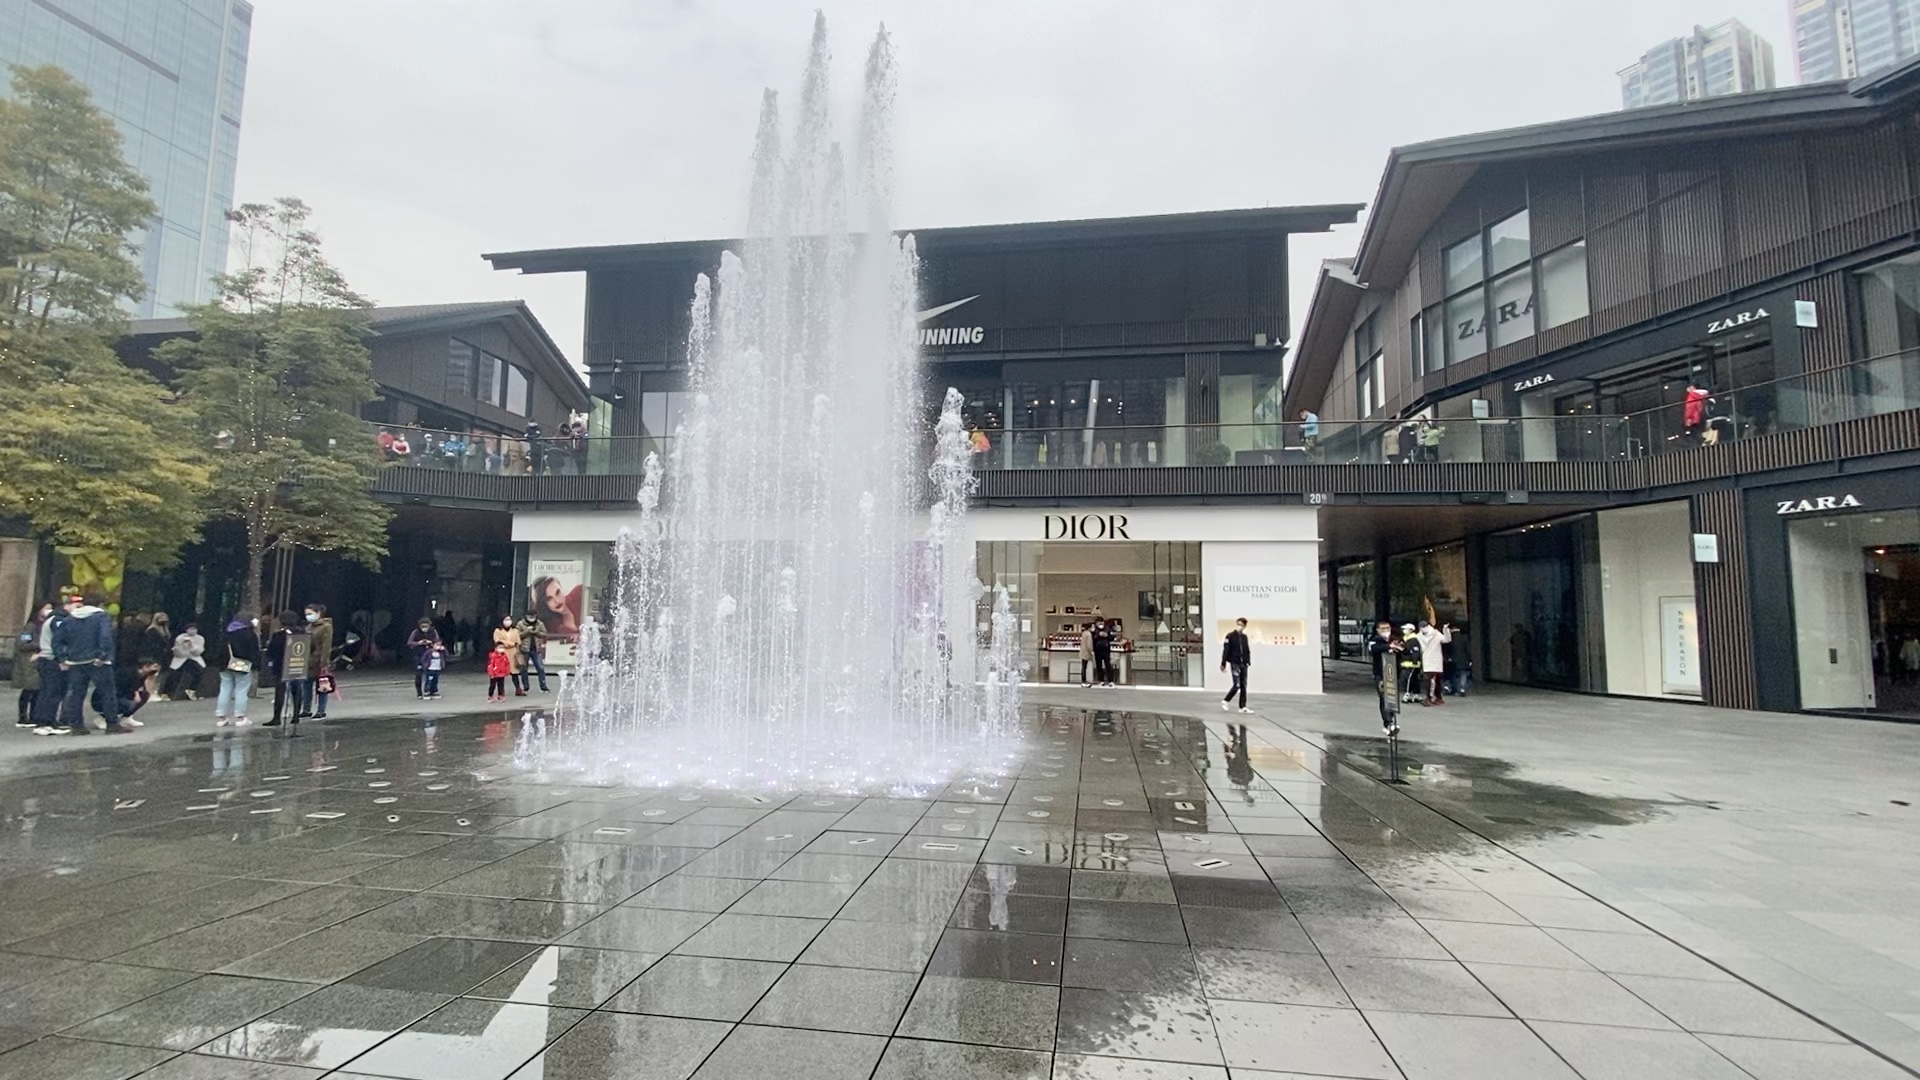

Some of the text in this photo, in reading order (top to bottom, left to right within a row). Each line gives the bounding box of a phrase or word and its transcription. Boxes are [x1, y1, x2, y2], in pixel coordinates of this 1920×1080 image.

[1707, 308, 1771, 334] ZARA
[1514, 373, 1555, 392] ZARA
[1776, 494, 1862, 515] ZARA
[1042, 514, 1130, 540] DIOR
[1222, 585, 1298, 593] CHRISTIAN DIOR
